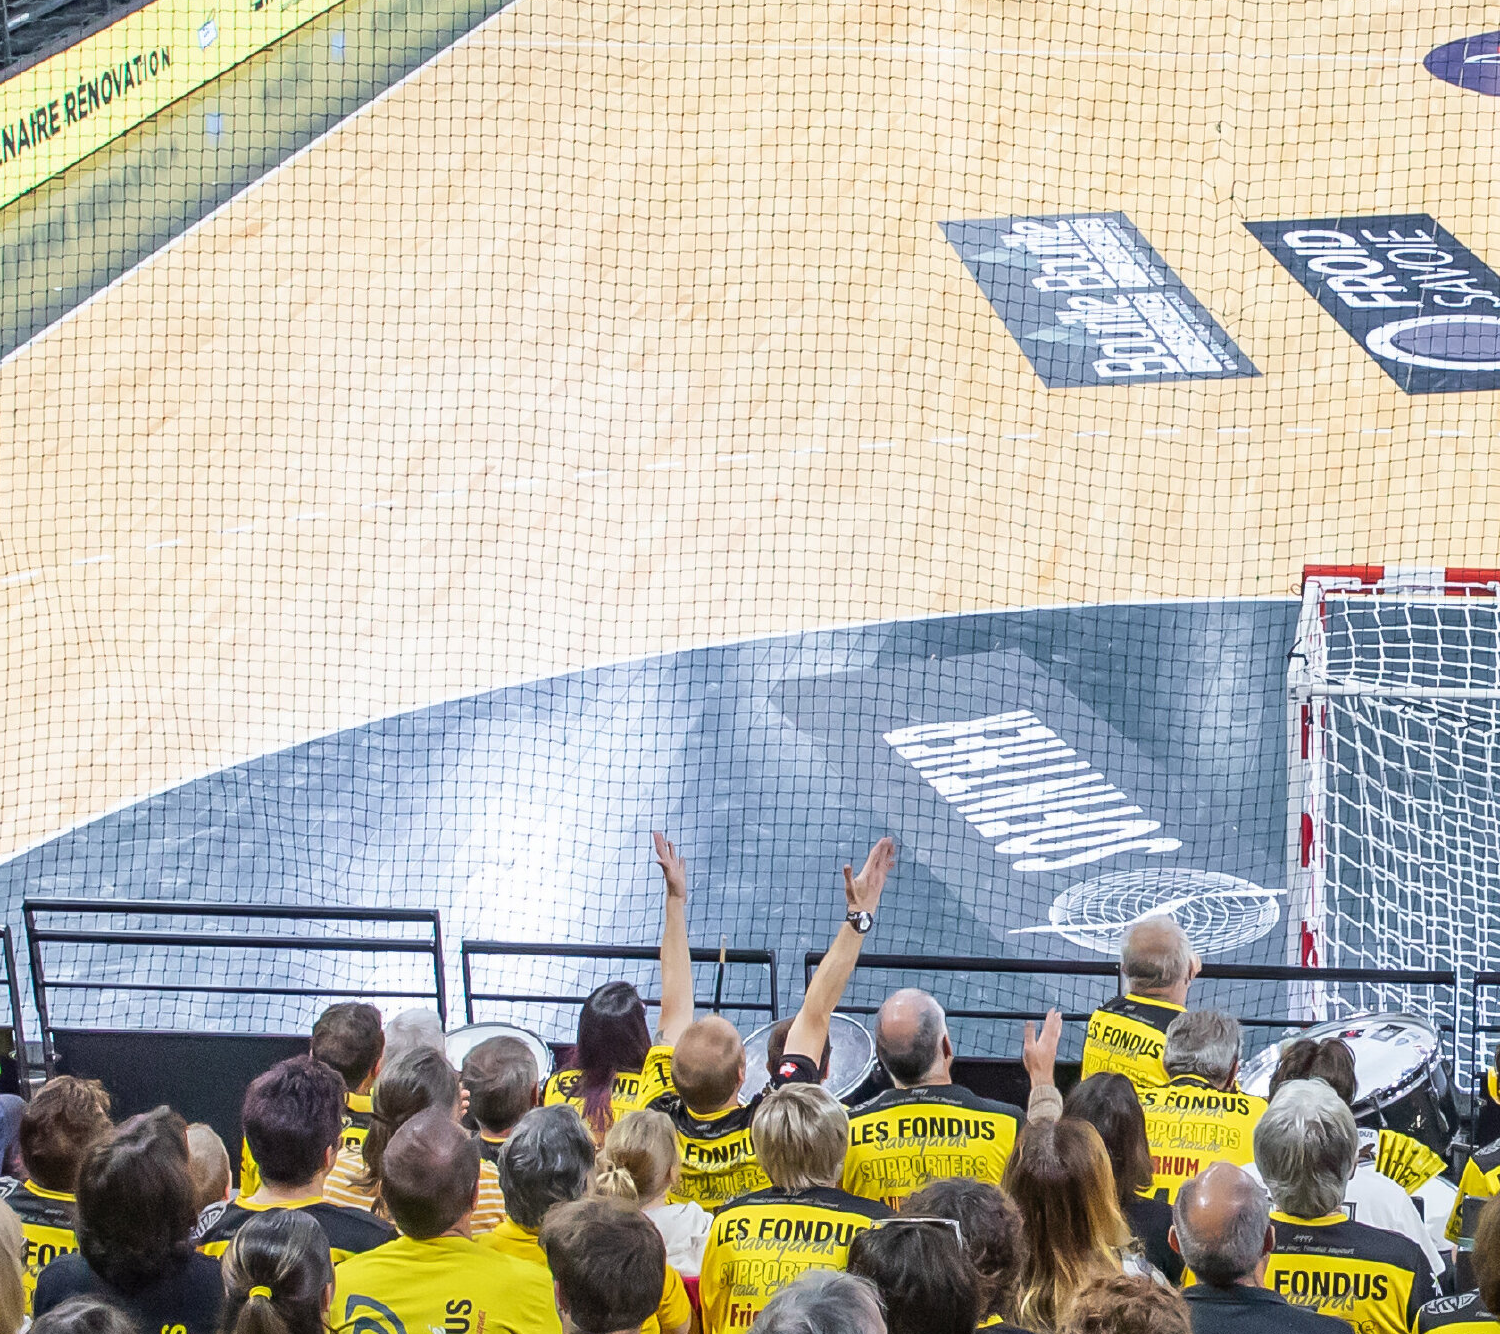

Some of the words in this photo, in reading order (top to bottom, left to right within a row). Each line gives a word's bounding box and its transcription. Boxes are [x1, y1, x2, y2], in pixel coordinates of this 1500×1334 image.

[65, 49, 172, 129] RÉNOVATION
[1282, 229, 1424, 309] FROID
[883, 708, 1184, 872] SOFINTHER
[1102, 1026, 1164, 1060] FONDUS
[1166, 1090, 1250, 1117] FONDUS
[851, 1123, 889, 1147] LES
[897, 1117, 996, 1142] FONDUS
[685, 1142, 755, 1162] FONDU
[861, 1153, 988, 1183] SUPPORTERS
[716, 1216, 748, 1246] LES
[1274, 1269, 1388, 1302] FONDUS
